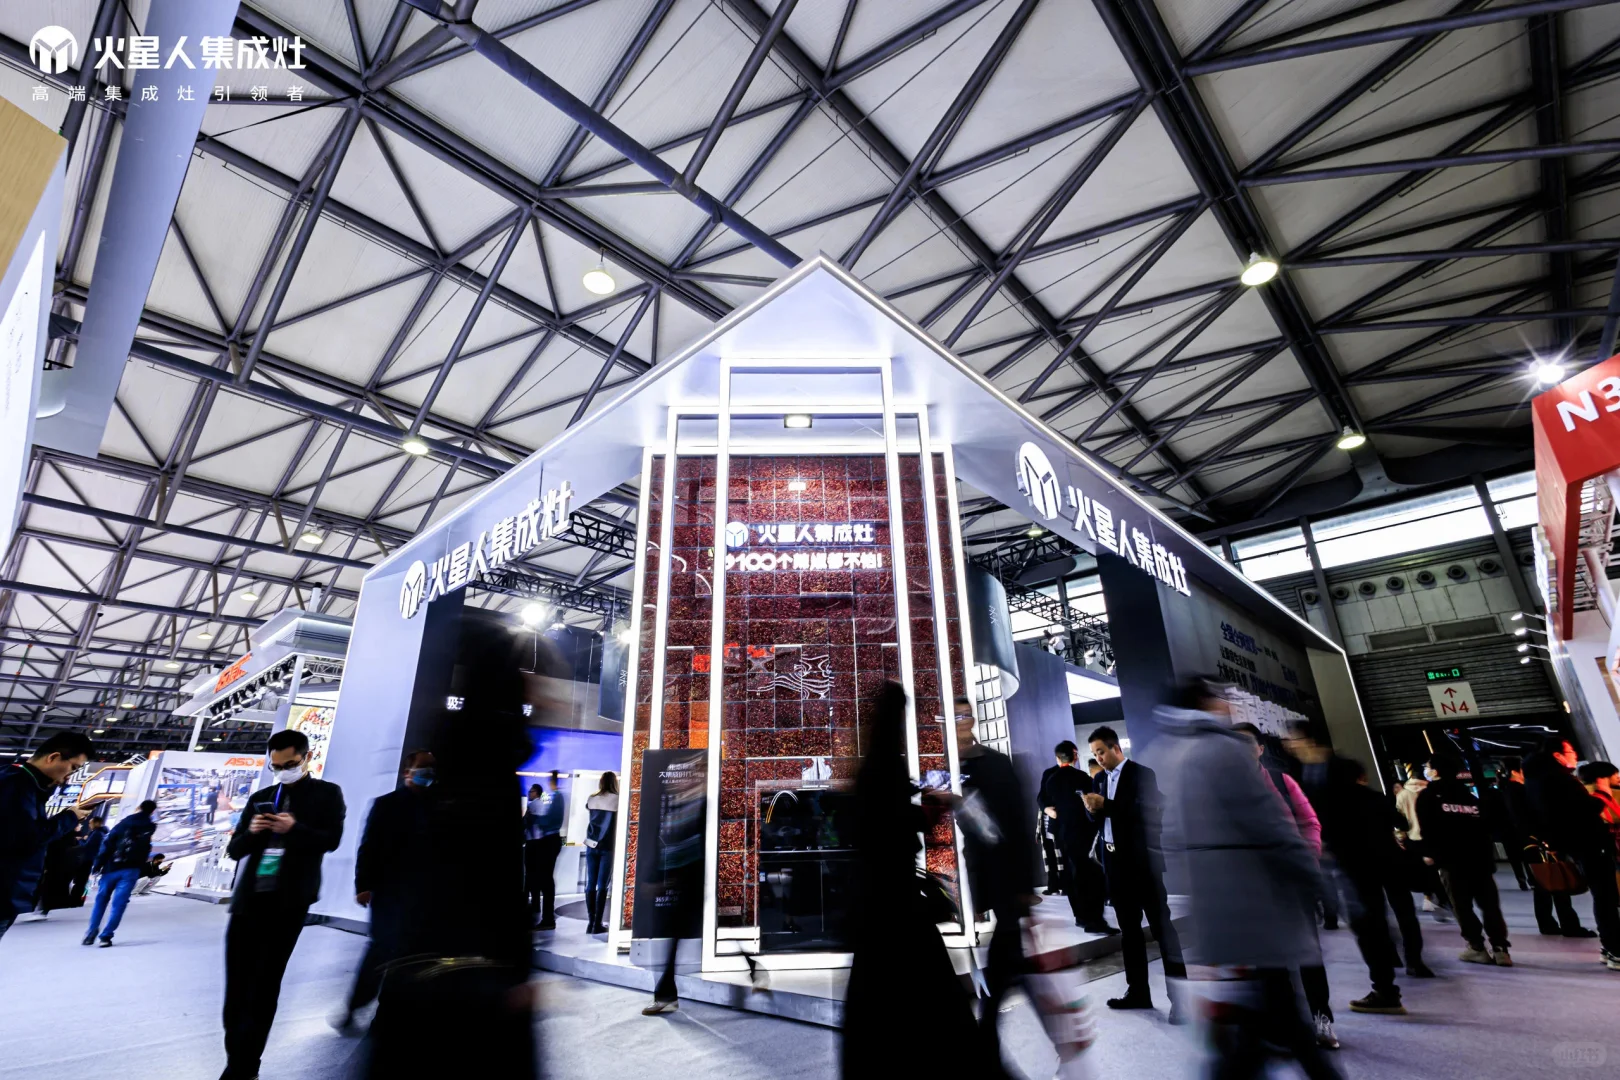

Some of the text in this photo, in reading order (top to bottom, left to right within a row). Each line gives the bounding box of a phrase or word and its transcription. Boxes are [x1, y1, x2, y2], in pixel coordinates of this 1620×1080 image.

[428, 480, 574, 603] 火星人集成灶
[758, 524, 873, 543] 火星人集成灶
[1067, 484, 1191, 597] 火星人集成灶
[1440, 700, 1470, 715] N4
